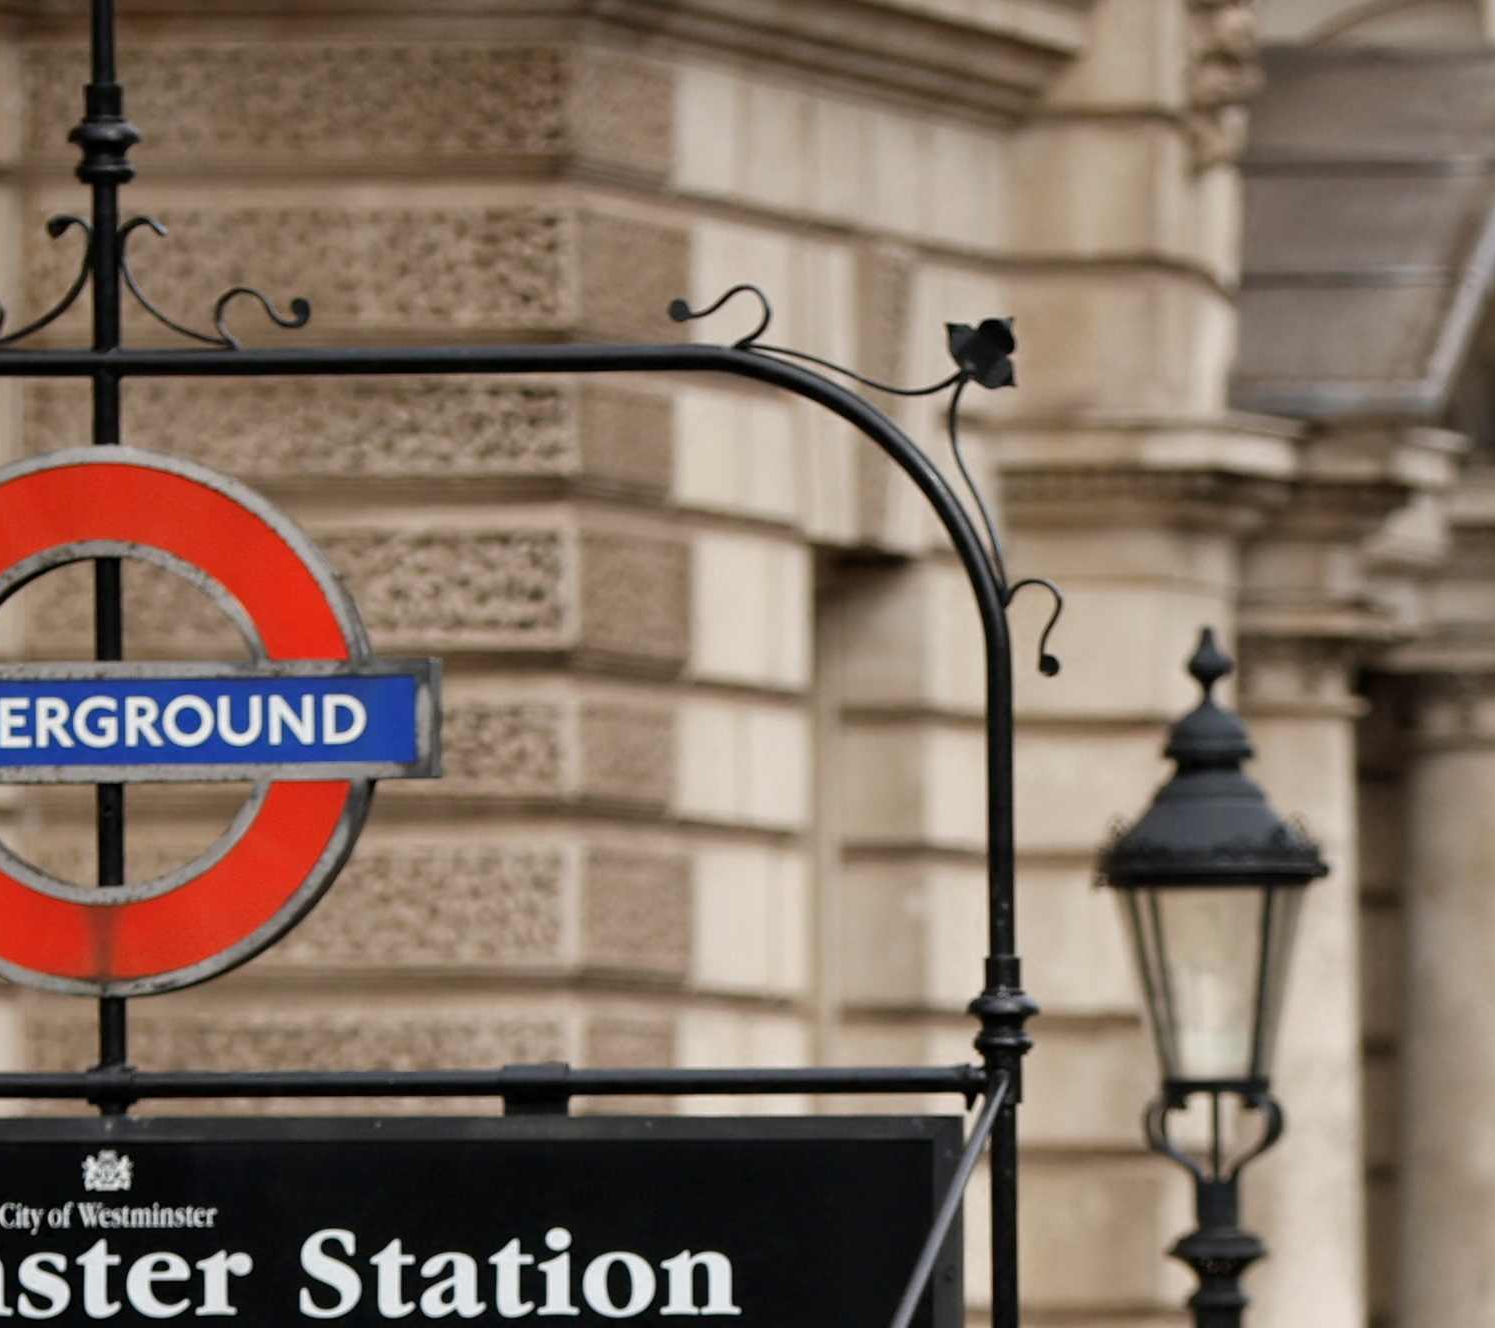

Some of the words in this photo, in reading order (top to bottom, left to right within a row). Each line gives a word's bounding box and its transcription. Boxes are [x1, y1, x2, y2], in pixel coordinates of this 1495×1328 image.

[47, 1201, 74, 1228] of
[77, 1202, 217, 1229] Westminster
[299, 1227, 741, 1318] Station
